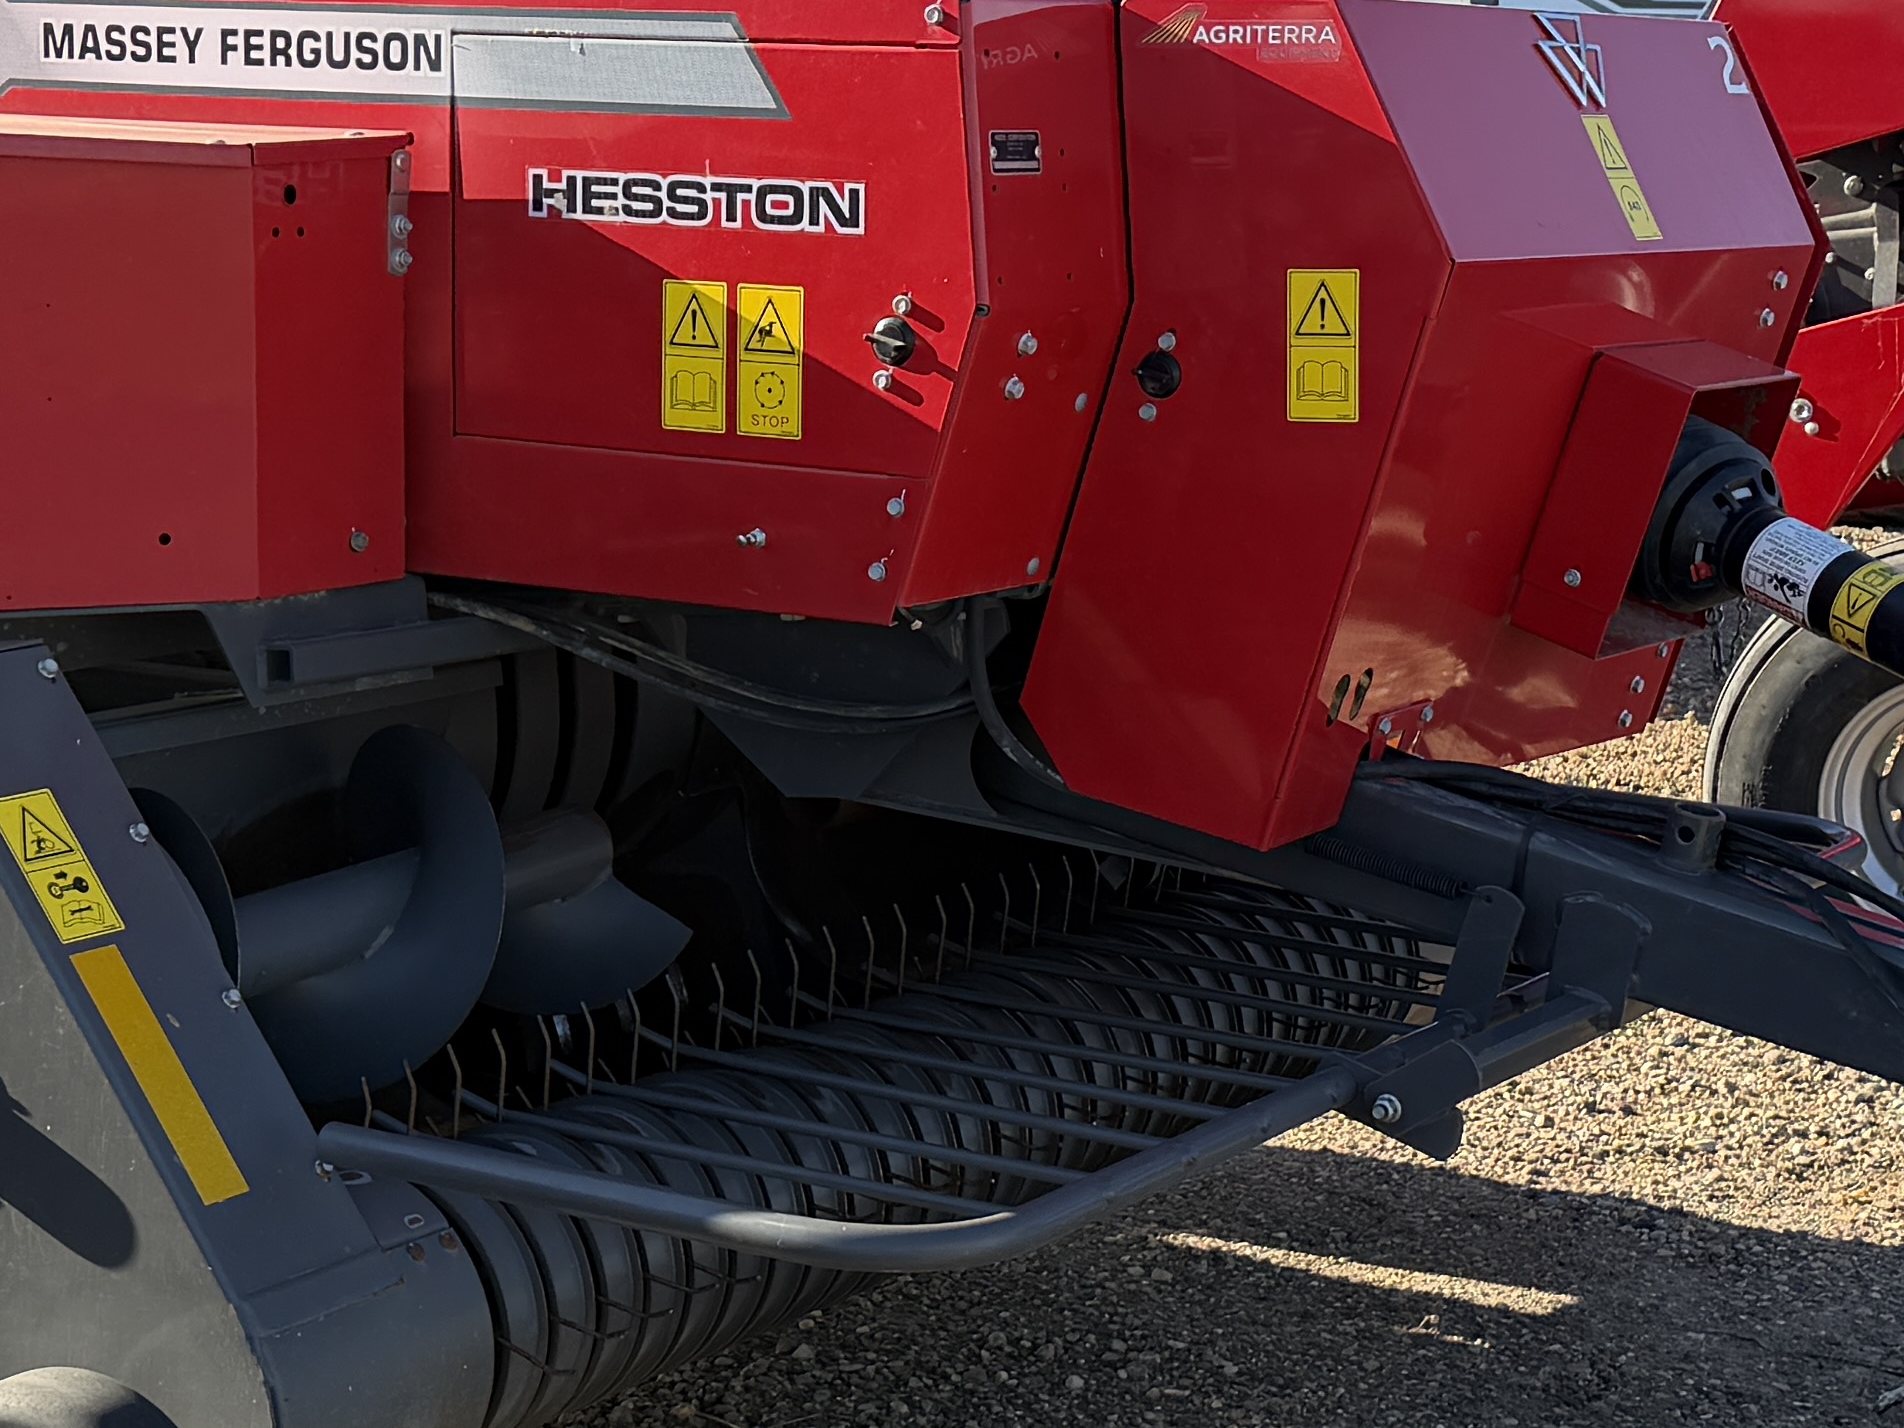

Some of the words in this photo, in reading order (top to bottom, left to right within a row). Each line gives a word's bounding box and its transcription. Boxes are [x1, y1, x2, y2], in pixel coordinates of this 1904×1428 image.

[42, 21, 204, 65] MASSEY
[220, 27, 443, 73] FERGUSON
[1192, 24, 1337, 45] AGRITERRA
[530, 171, 863, 232] HESSTON
[750, 413, 790, 429] STOP
